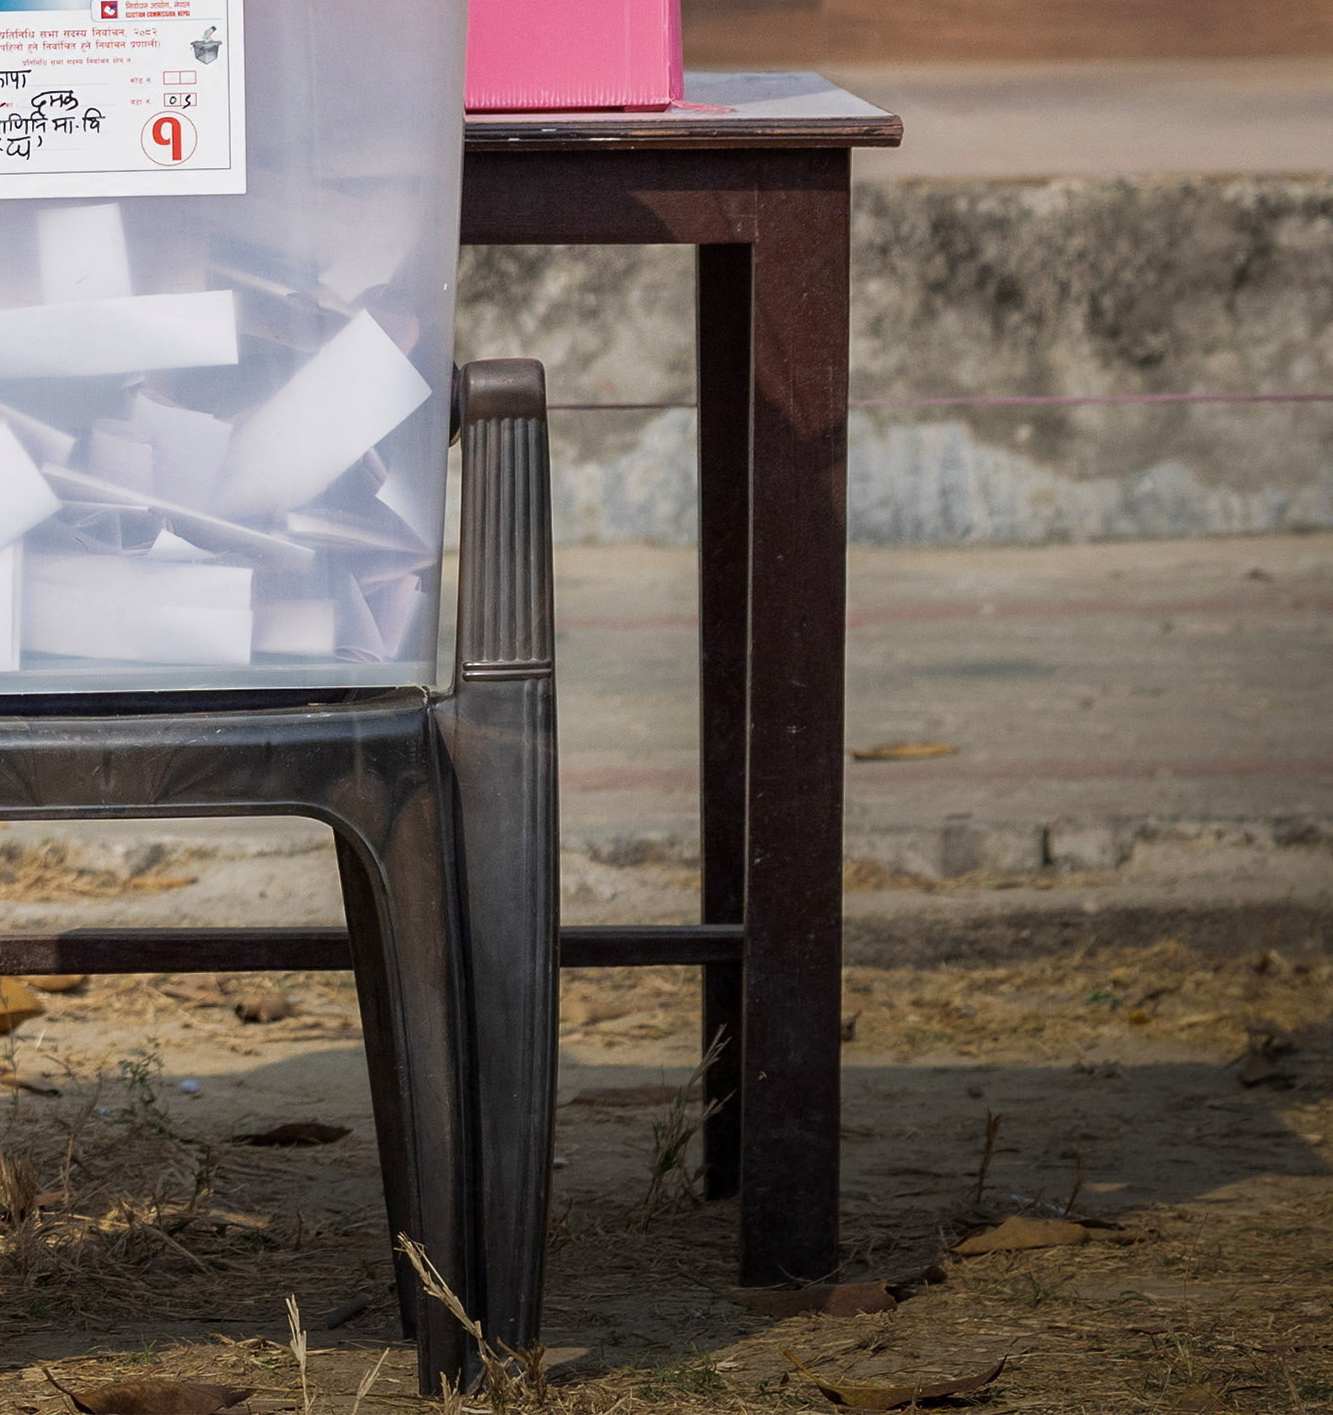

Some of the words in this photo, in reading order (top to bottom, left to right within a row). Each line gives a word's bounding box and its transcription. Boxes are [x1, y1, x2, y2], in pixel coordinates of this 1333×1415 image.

[0, 28, 35, 39] प्रतिनिधि
[39, 30, 59, 39] सभा
[63, 29, 87, 38] सदस्य
[27, 41, 39, 54] हुने
[42, 39, 76, 51] निर्वाचित
[80, 40, 91, 53] हुने
[95, 38, 126, 49] निर्वाचन
[31, 89, 79, 117] दमक
[152, 116, 182, 161] १
